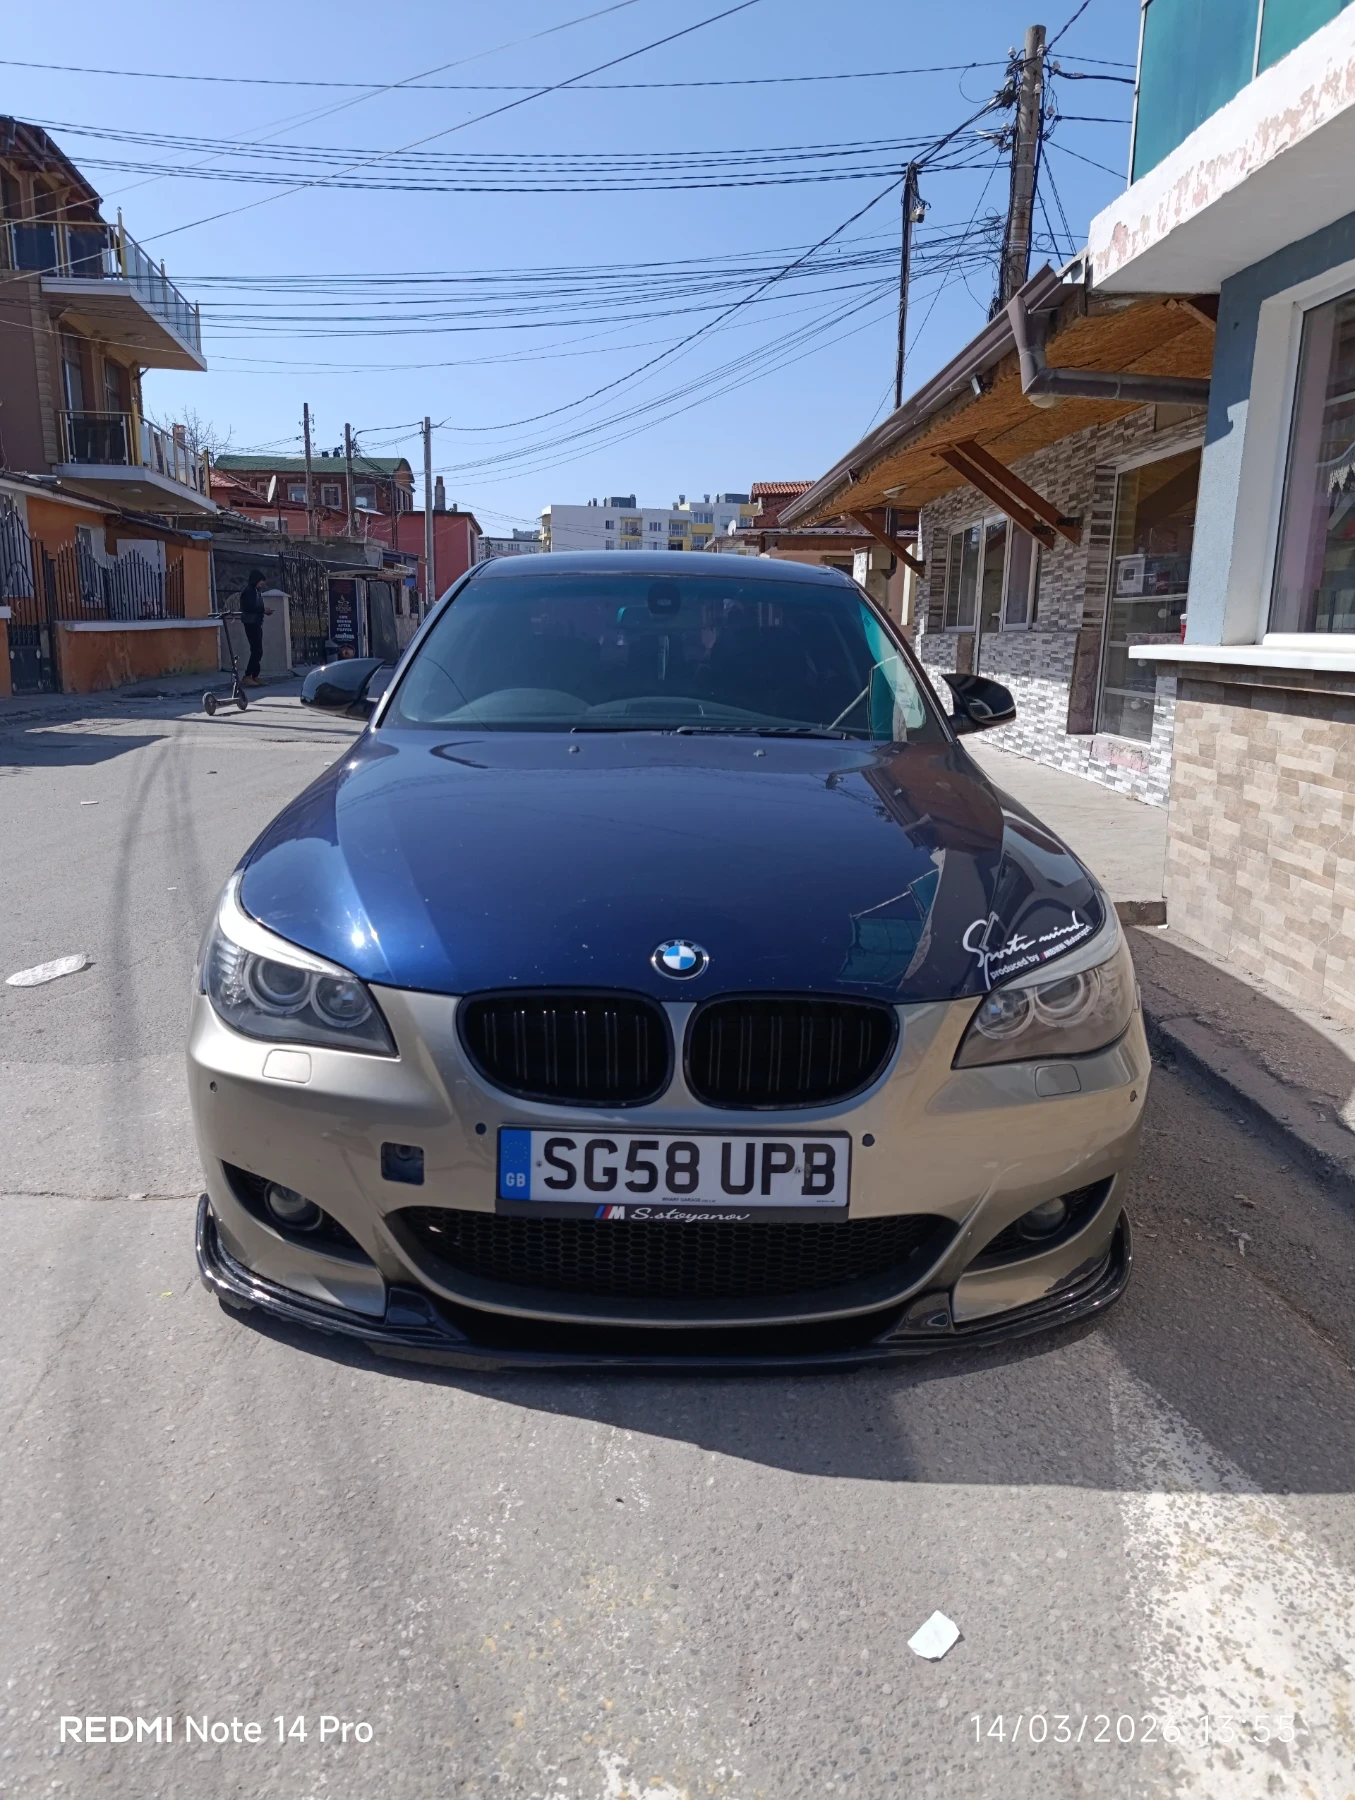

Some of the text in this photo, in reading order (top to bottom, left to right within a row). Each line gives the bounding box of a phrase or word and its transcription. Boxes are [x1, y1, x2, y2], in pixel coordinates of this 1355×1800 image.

[1039, 910, 1084, 942] mind
[658, 940, 702, 952] BMW
[990, 956, 1029, 980] produced
[1027, 953, 1040, 962] by
[506, 1172, 526, 1187] GB
[543, 1137, 836, 1196] SG58 UPB
